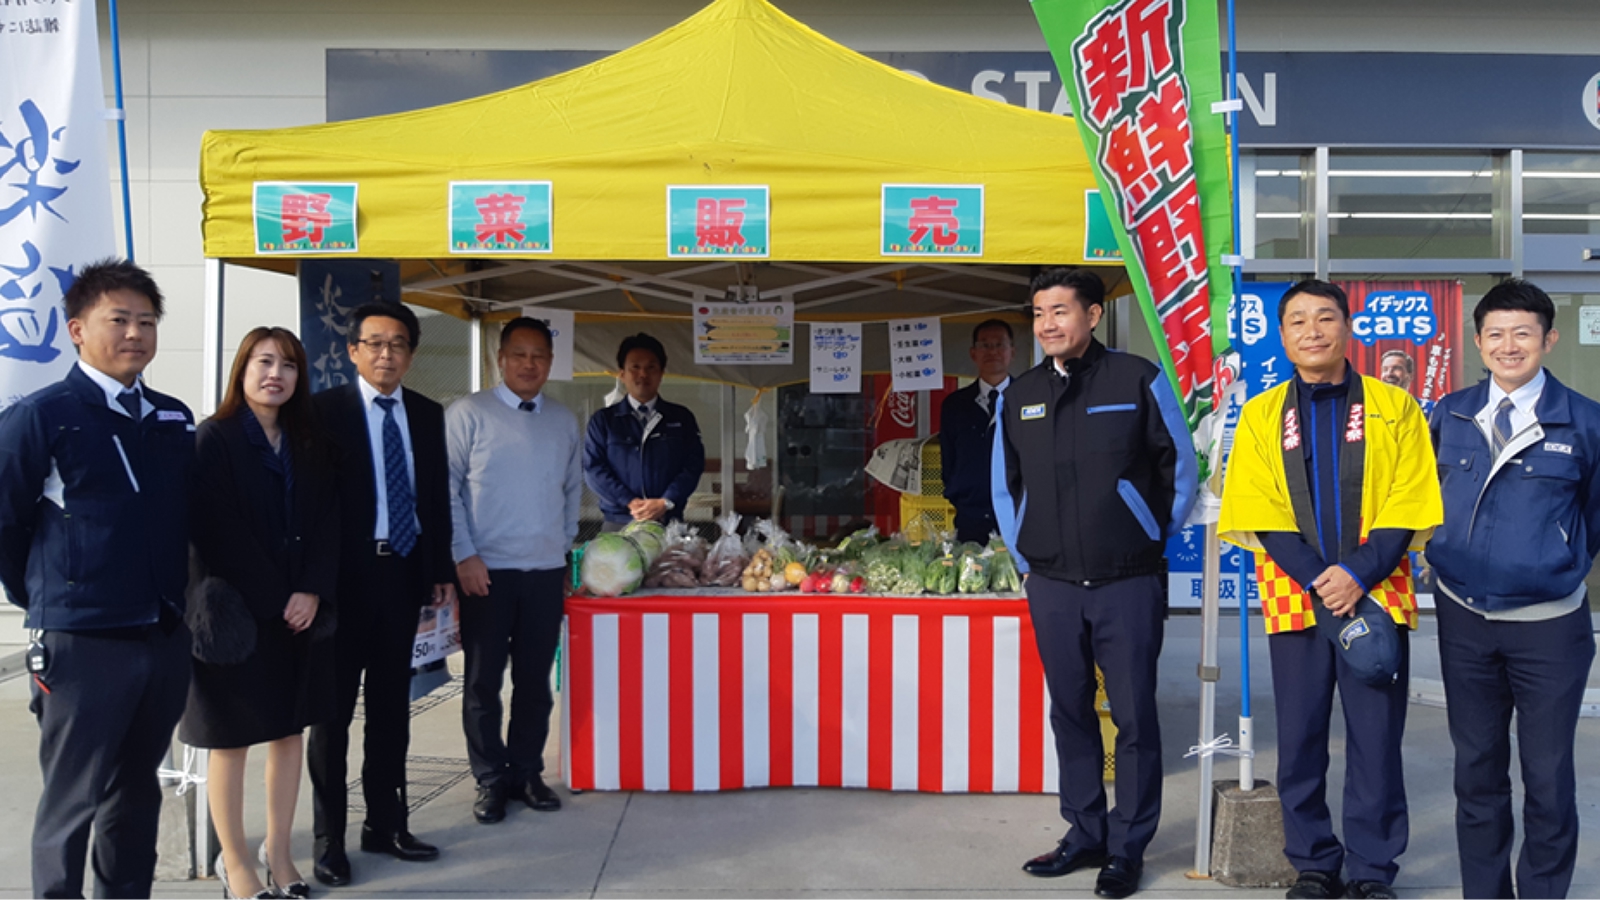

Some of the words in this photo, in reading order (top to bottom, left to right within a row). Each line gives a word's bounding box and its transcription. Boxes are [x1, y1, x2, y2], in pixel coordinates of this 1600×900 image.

[281, 193, 332, 244] 野
[475, 193, 526, 244] 菜
[696, 198, 746, 248] 販
[908, 196, 959, 246] 売
[1368, 295, 1428, 312] イデックス
[1352, 316, 1431, 335] cars
